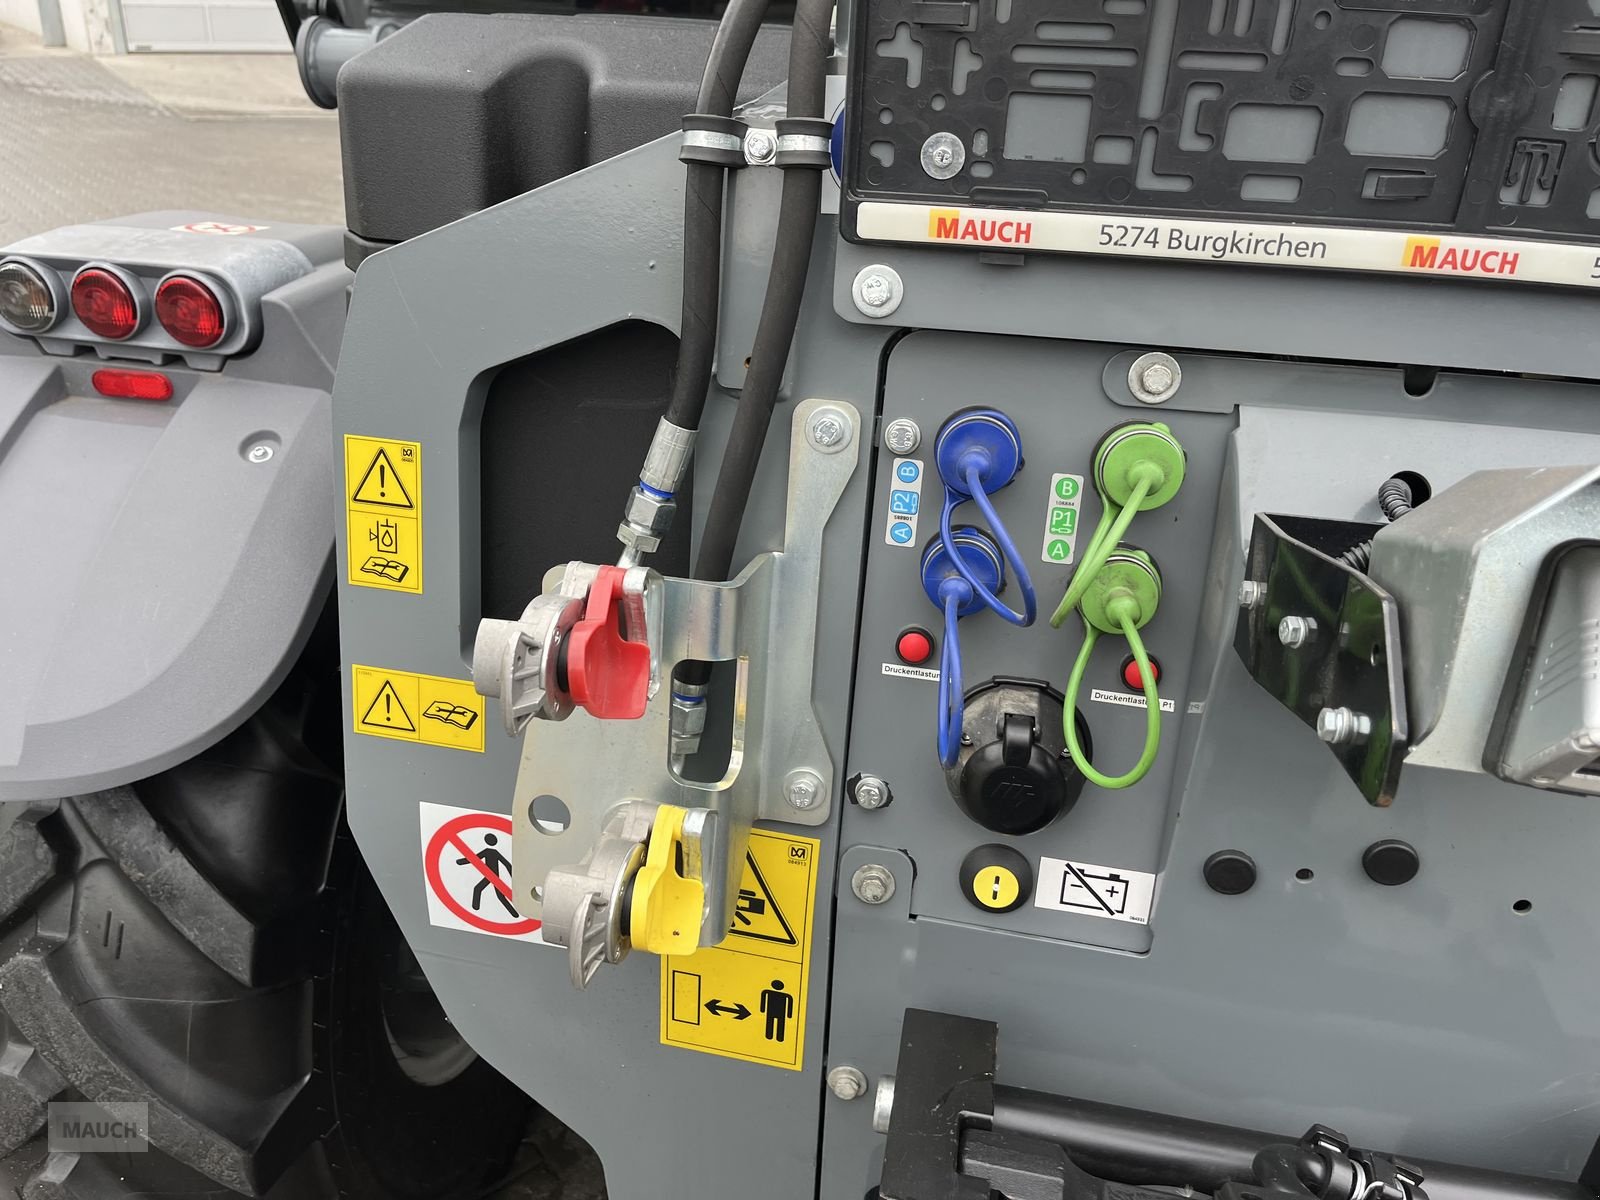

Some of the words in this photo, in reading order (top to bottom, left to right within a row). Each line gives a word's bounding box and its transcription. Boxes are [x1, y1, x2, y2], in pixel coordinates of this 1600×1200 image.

[936, 217, 1032, 244] MAUCH
[1099, 224, 1159, 248] 5274
[1167, 228, 1327, 259] Burgkirchen
[1410, 245, 1519, 275] MAUCH
[900, 466, 915, 477] B
[1062, 480, 1073, 496] B
[893, 493, 910, 512] P2
[1052, 510, 1072, 527] P1
[894, 527, 909, 539] A
[1051, 543, 1064, 558] A
[1162, 701, 1172, 709] P1
